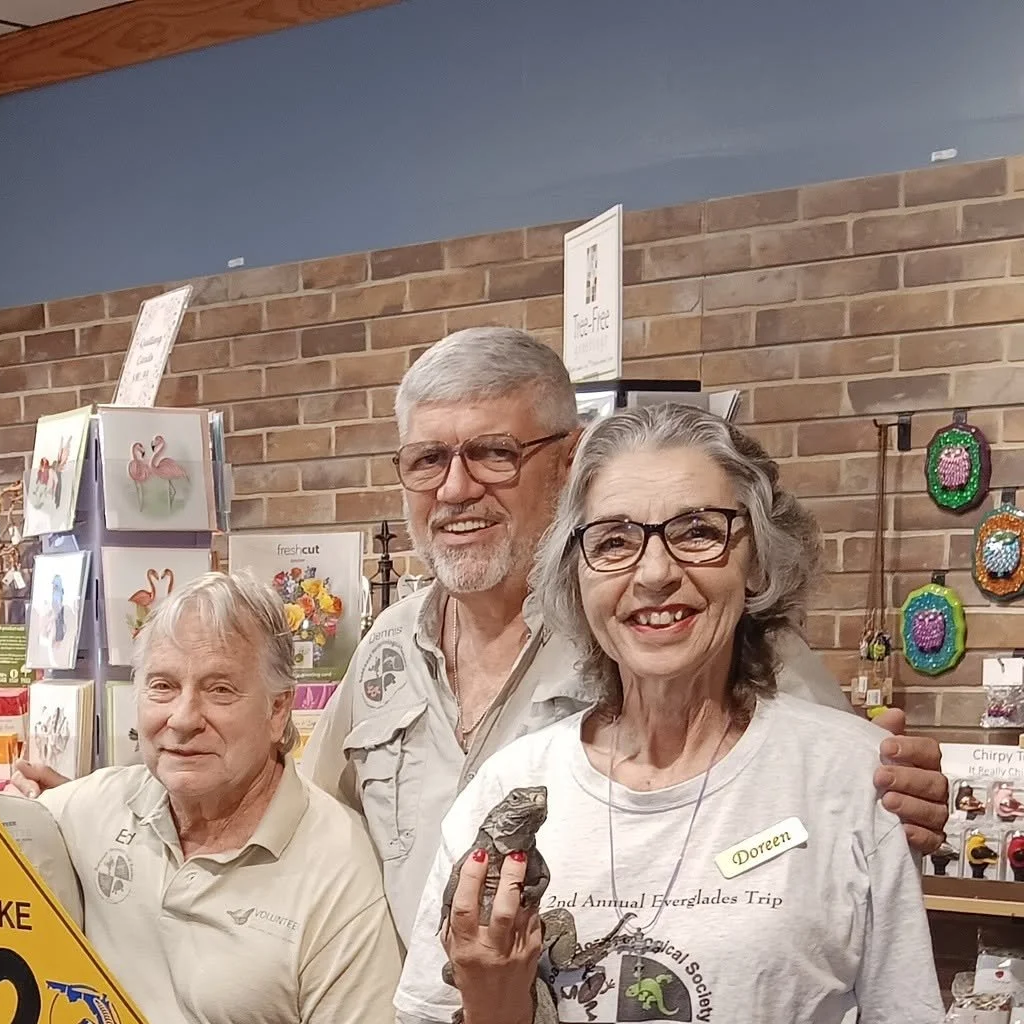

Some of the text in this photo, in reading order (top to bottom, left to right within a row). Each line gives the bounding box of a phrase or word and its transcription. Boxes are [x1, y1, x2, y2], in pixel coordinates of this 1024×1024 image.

[277, 543, 320, 556] freshcut
[973, 748, 1014, 764] Chirpy
[978, 766, 1007, 778] Really
[732, 831, 792, 866] Doreen
[546, 889, 783, 910] 2nd Annual Everglades Trip
[686, 961, 713, 1023] Society
